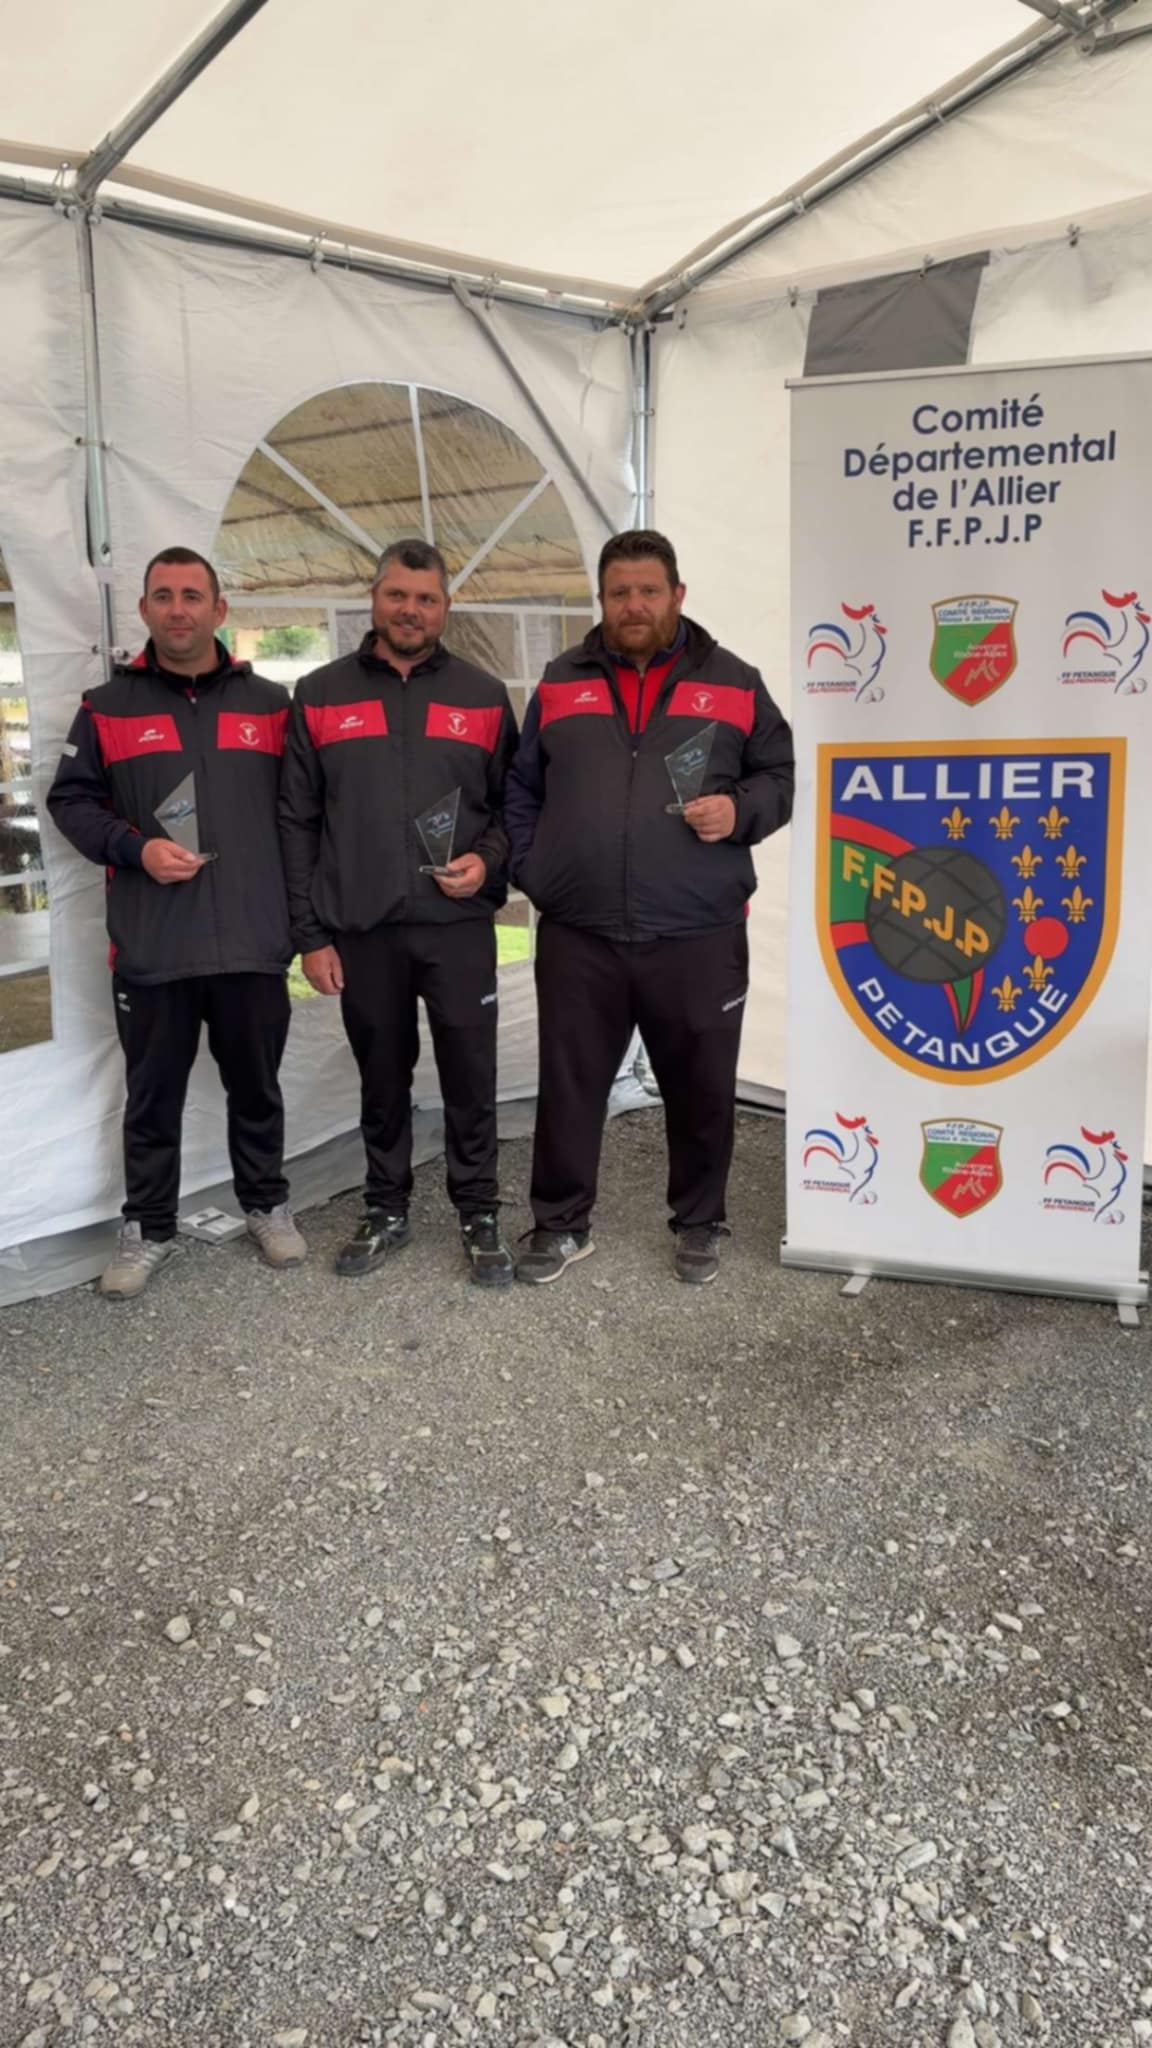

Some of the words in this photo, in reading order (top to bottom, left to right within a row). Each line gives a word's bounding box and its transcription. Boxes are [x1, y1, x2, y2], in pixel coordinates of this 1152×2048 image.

[912, 393, 1044, 435] Comité
[844, 430, 1117, 481] Départemental
[893, 481, 938, 511] de
[908, 513, 1042, 548] F.F.P.J.P
[840, 761, 1095, 801] ALLIER
[842, 845, 990, 957] F.F.P.J.P
[857, 977, 1069, 1065] PETANQUE
